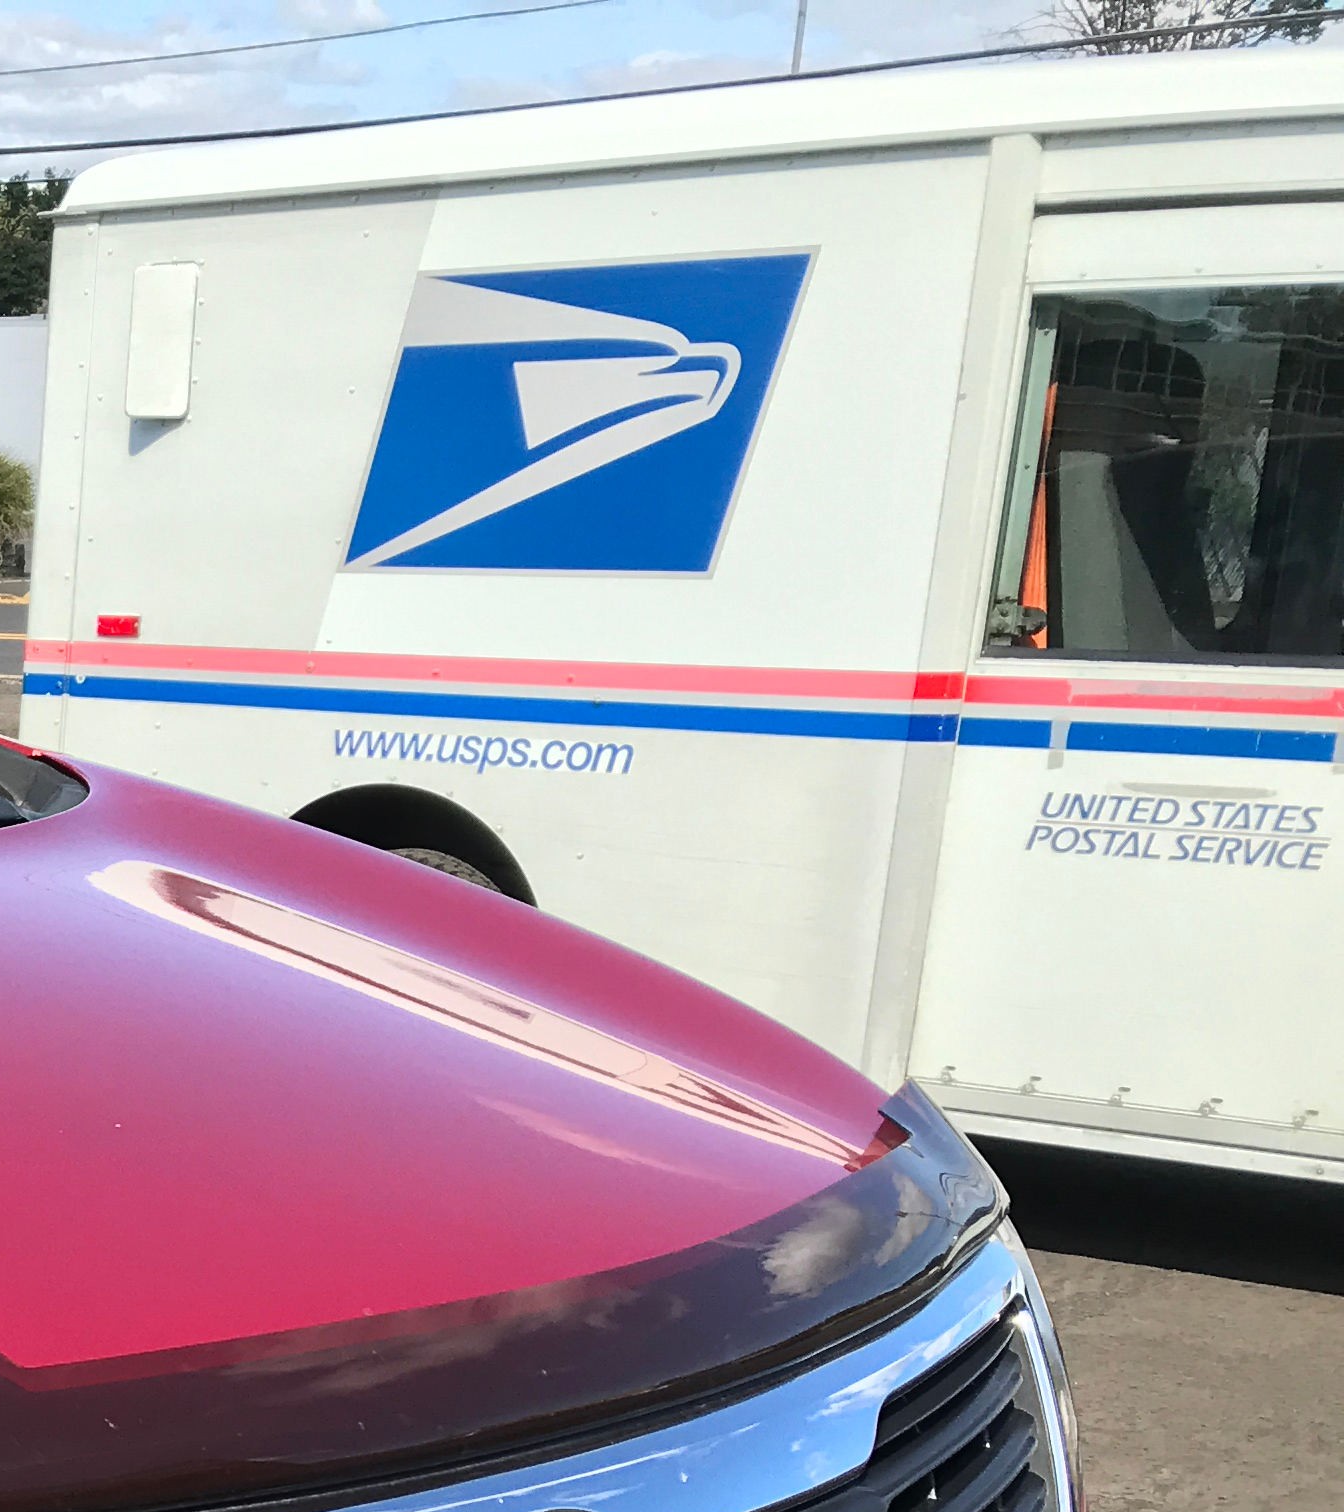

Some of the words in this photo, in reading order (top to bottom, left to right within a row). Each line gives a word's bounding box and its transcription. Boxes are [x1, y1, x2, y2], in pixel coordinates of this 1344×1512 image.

[334, 729, 634, 775] www.usps.com
[1040, 792, 1181, 825] UNITED
[1184, 800, 1324, 834] STATES
[1025, 824, 1161, 860] POSTAL
[1168, 833, 1330, 871] SERVICE
